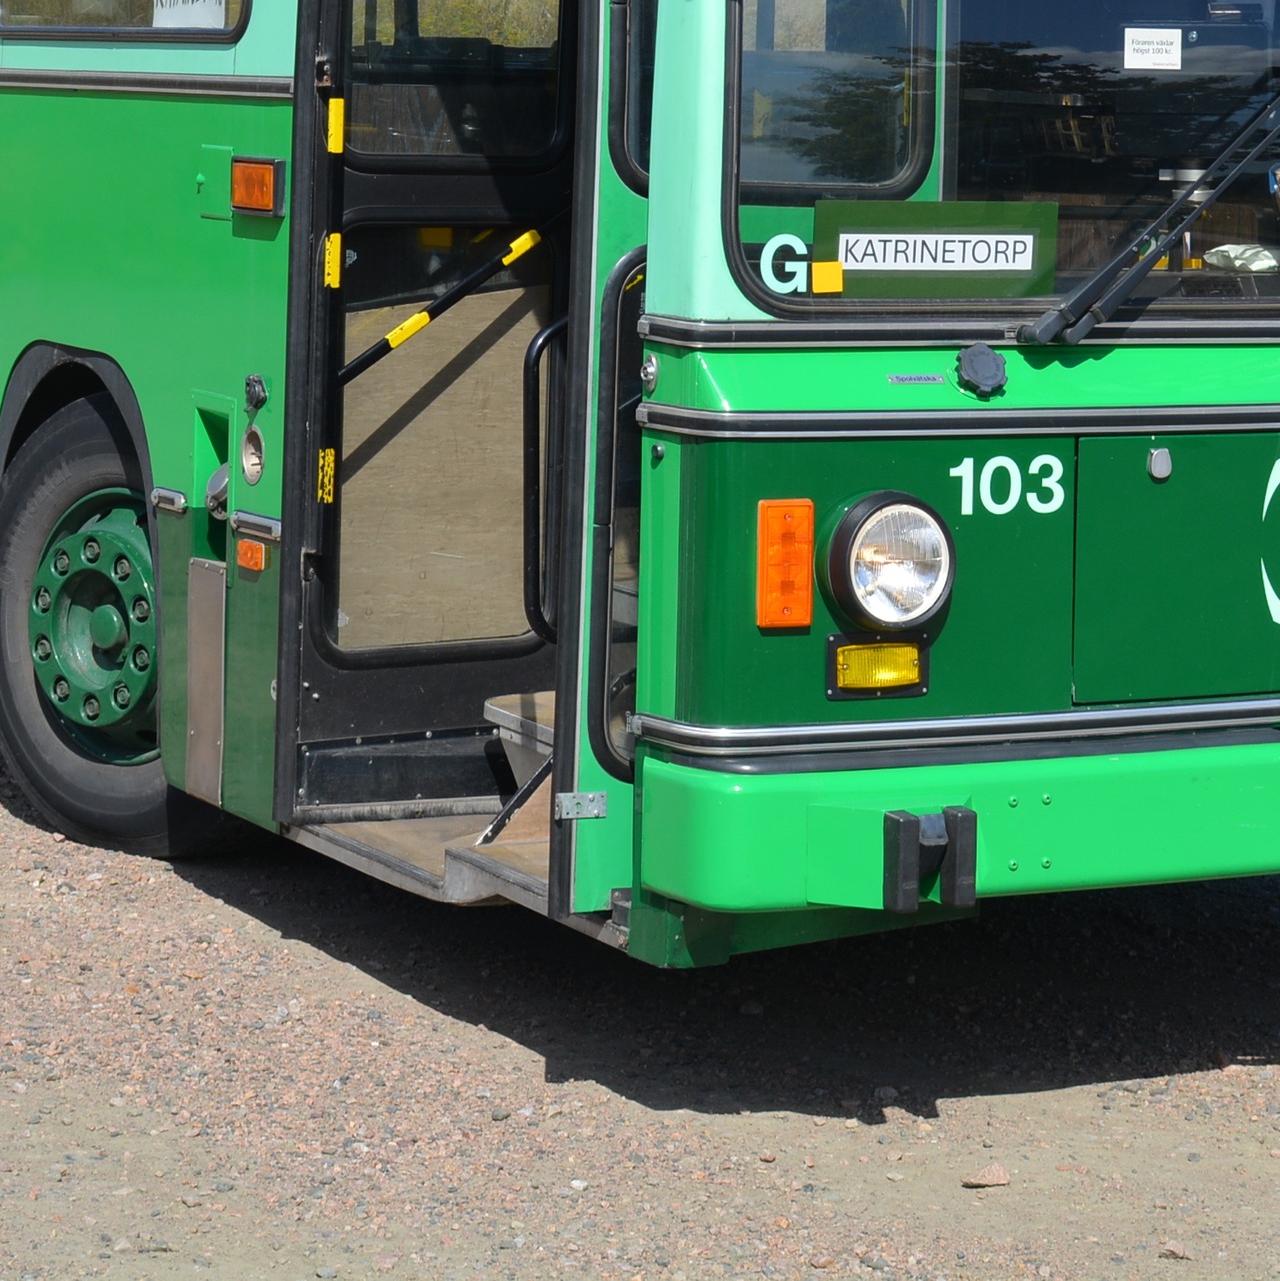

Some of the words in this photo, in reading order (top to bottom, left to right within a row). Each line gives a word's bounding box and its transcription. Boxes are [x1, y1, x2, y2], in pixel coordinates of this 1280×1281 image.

[1131, 38, 1155, 46] Föraren
[1132, 47, 1150, 55] högst
[1152, 47, 1164, 55] 100
[759, 233, 808, 294] G
[843, 238, 1028, 265] KATRINETORP
[949, 454, 1065, 515] 103
